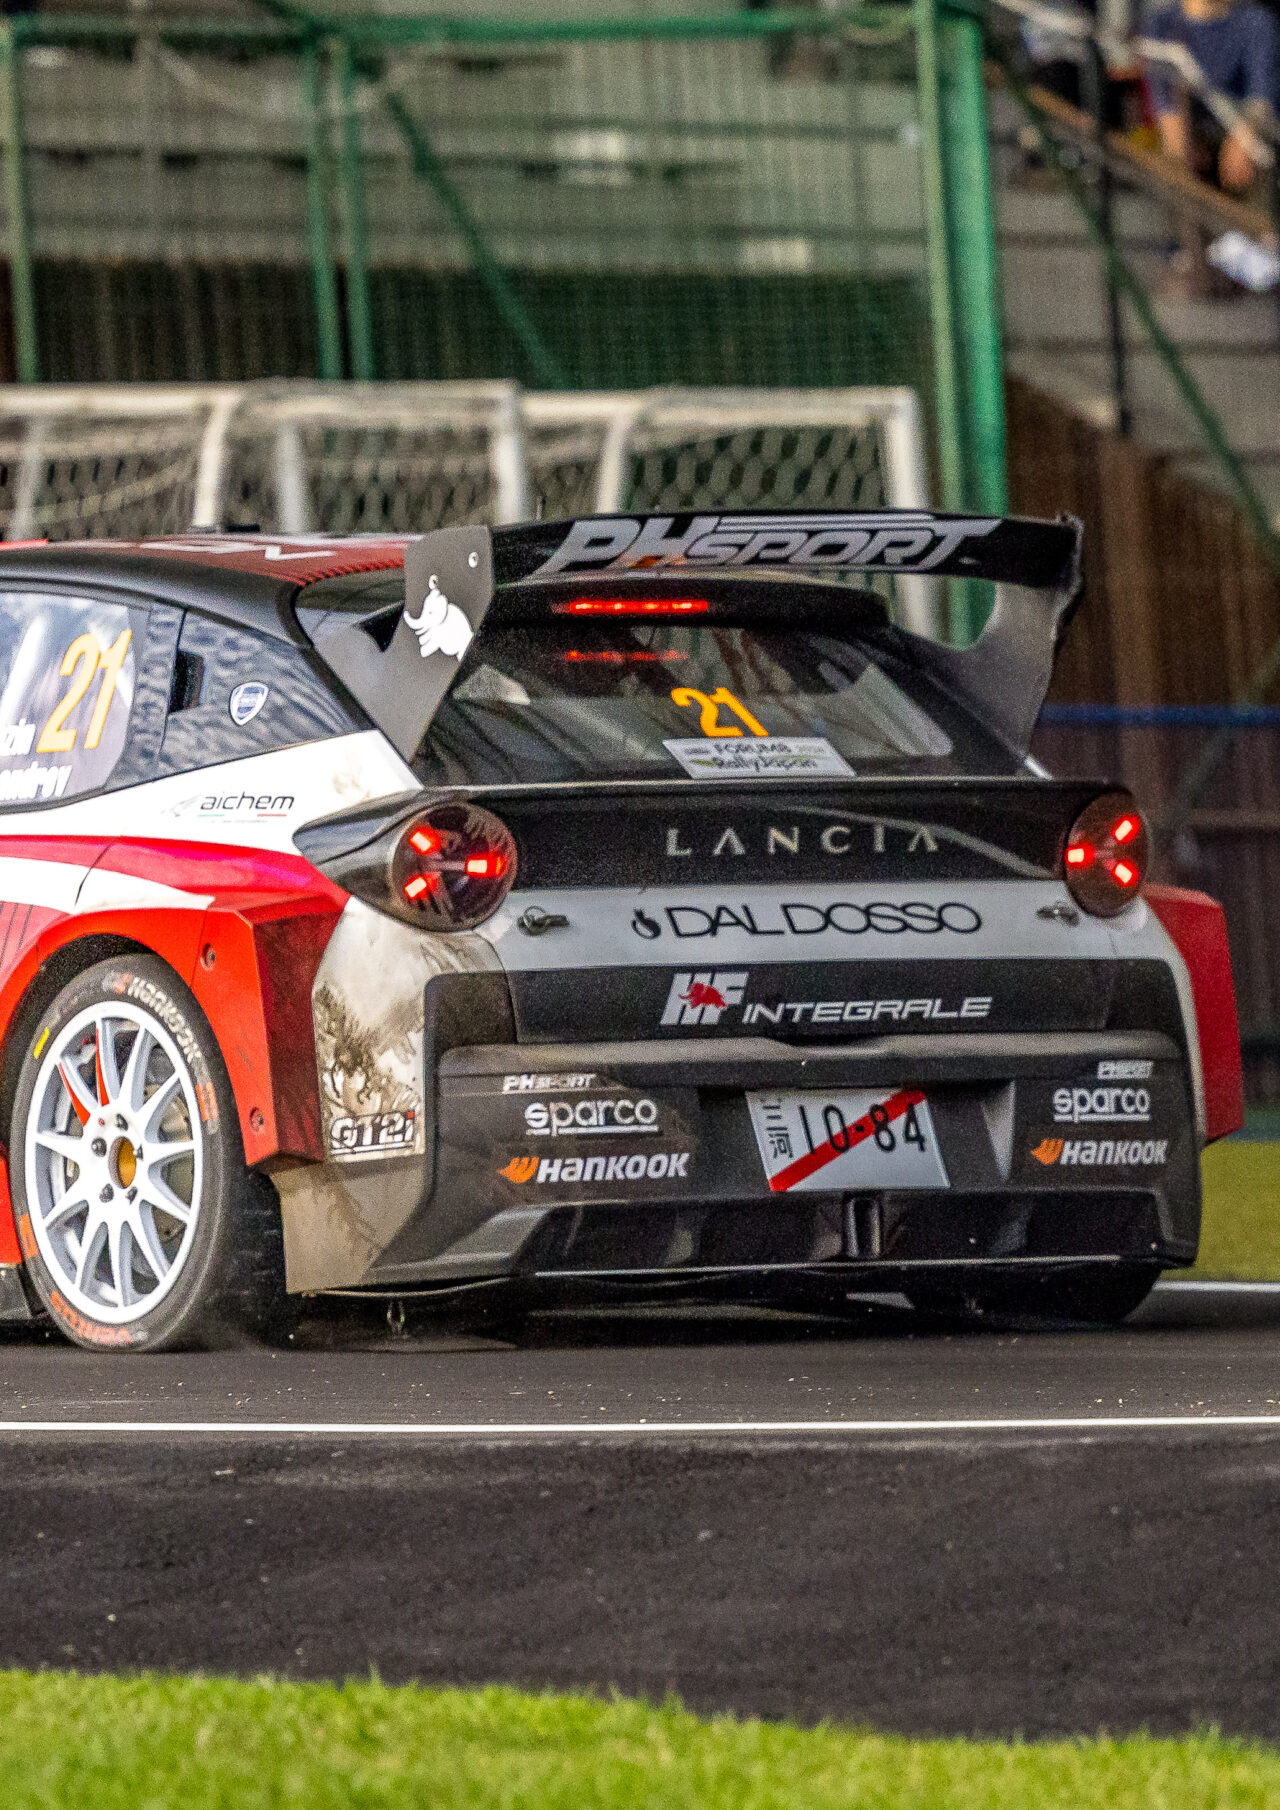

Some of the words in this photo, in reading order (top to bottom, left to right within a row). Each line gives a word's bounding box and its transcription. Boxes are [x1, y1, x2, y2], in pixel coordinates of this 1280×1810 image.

[36, 629, 133, 754] 21
[670, 686, 769, 738] 21
[200, 791, 295, 811] aichem
[666, 826, 939, 857] LANCIA
[742, 997, 993, 1024] INTEGRALE
[524, 1098, 658, 1136] sparco
[1052, 1086, 1151, 1123] sparco
[330, 1110, 415, 1149] GT2i
